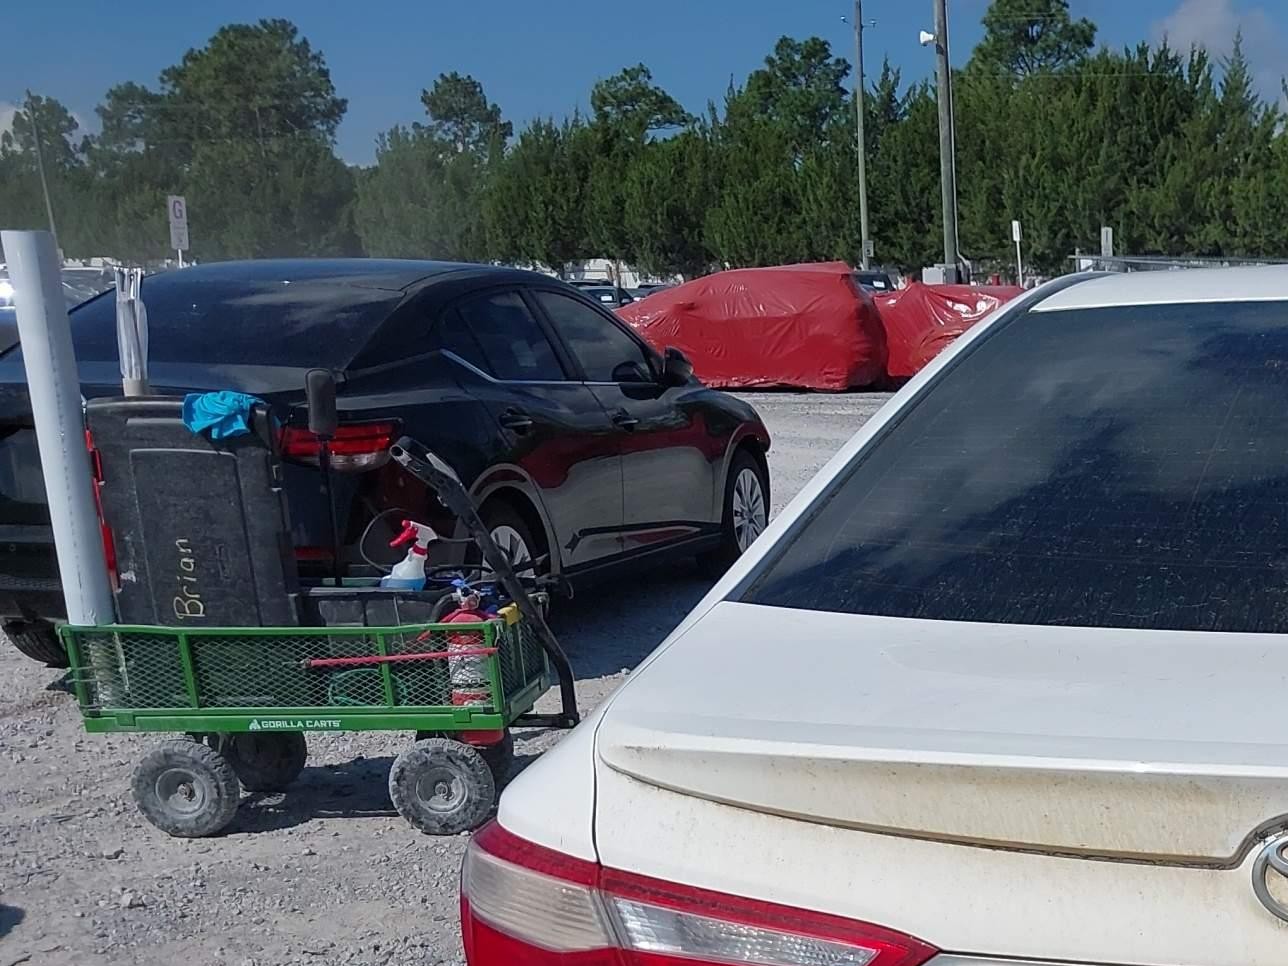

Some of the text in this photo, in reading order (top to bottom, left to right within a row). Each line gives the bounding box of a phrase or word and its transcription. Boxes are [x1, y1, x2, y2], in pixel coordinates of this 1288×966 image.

[173, 200, 183, 219] G
[174, 538, 205, 618] Brian
[261, 720, 304, 728] GORILLA
